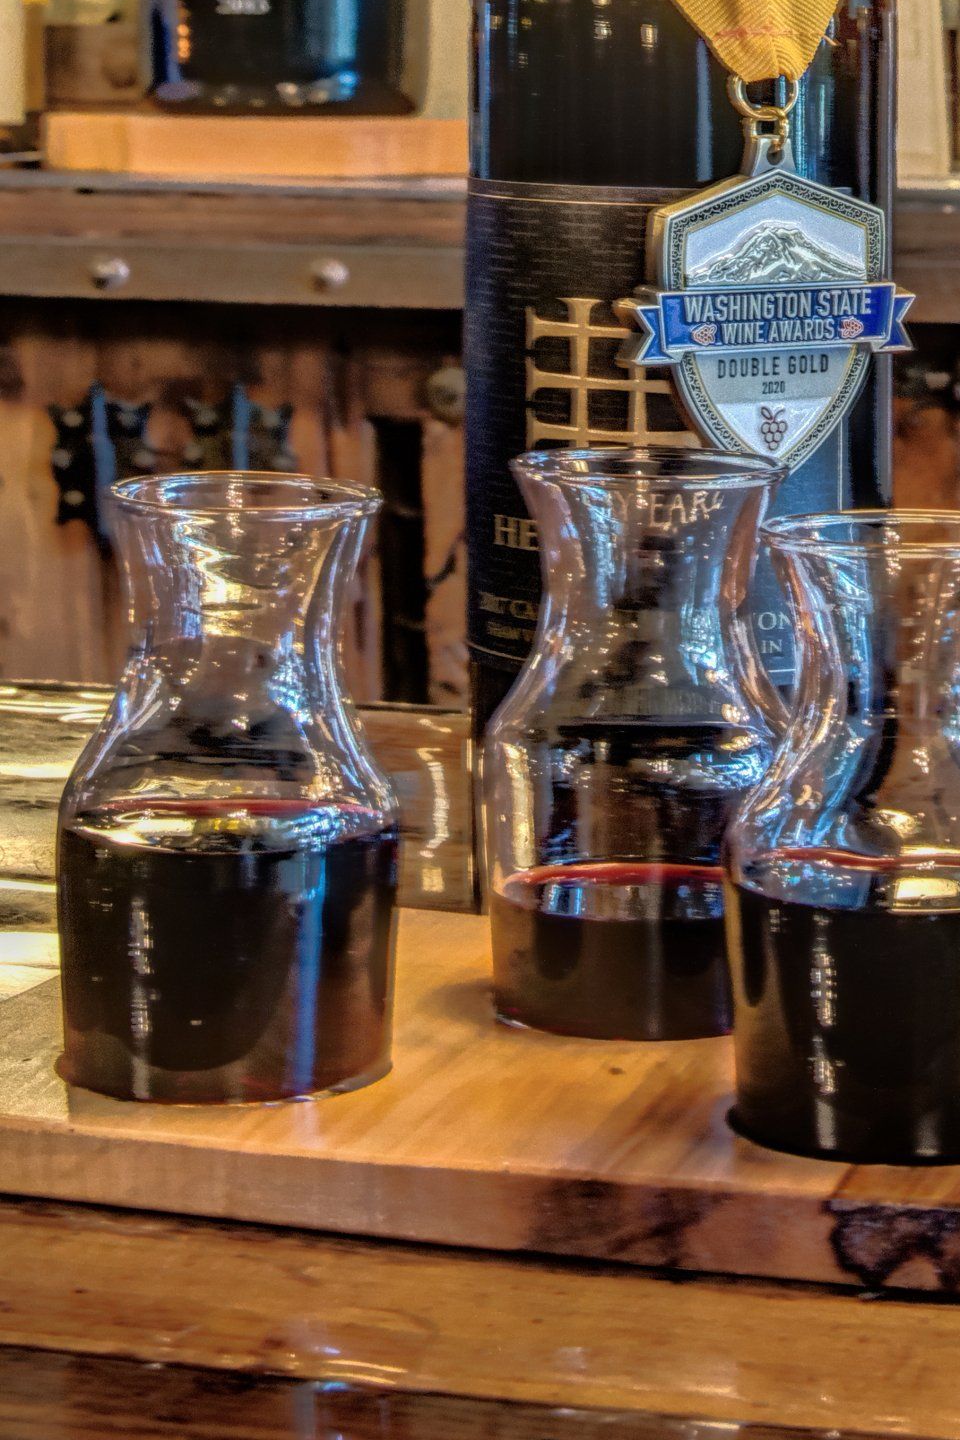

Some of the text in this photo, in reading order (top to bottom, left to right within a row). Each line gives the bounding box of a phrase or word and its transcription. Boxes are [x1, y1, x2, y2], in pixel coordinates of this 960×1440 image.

[684, 289, 872, 323] WASHINGTON STATE
[721, 318, 835, 344] WINE AWARDS
[718, 354, 829, 379] DOUBLE GOLD
[762, 381, 786, 394] 2020
